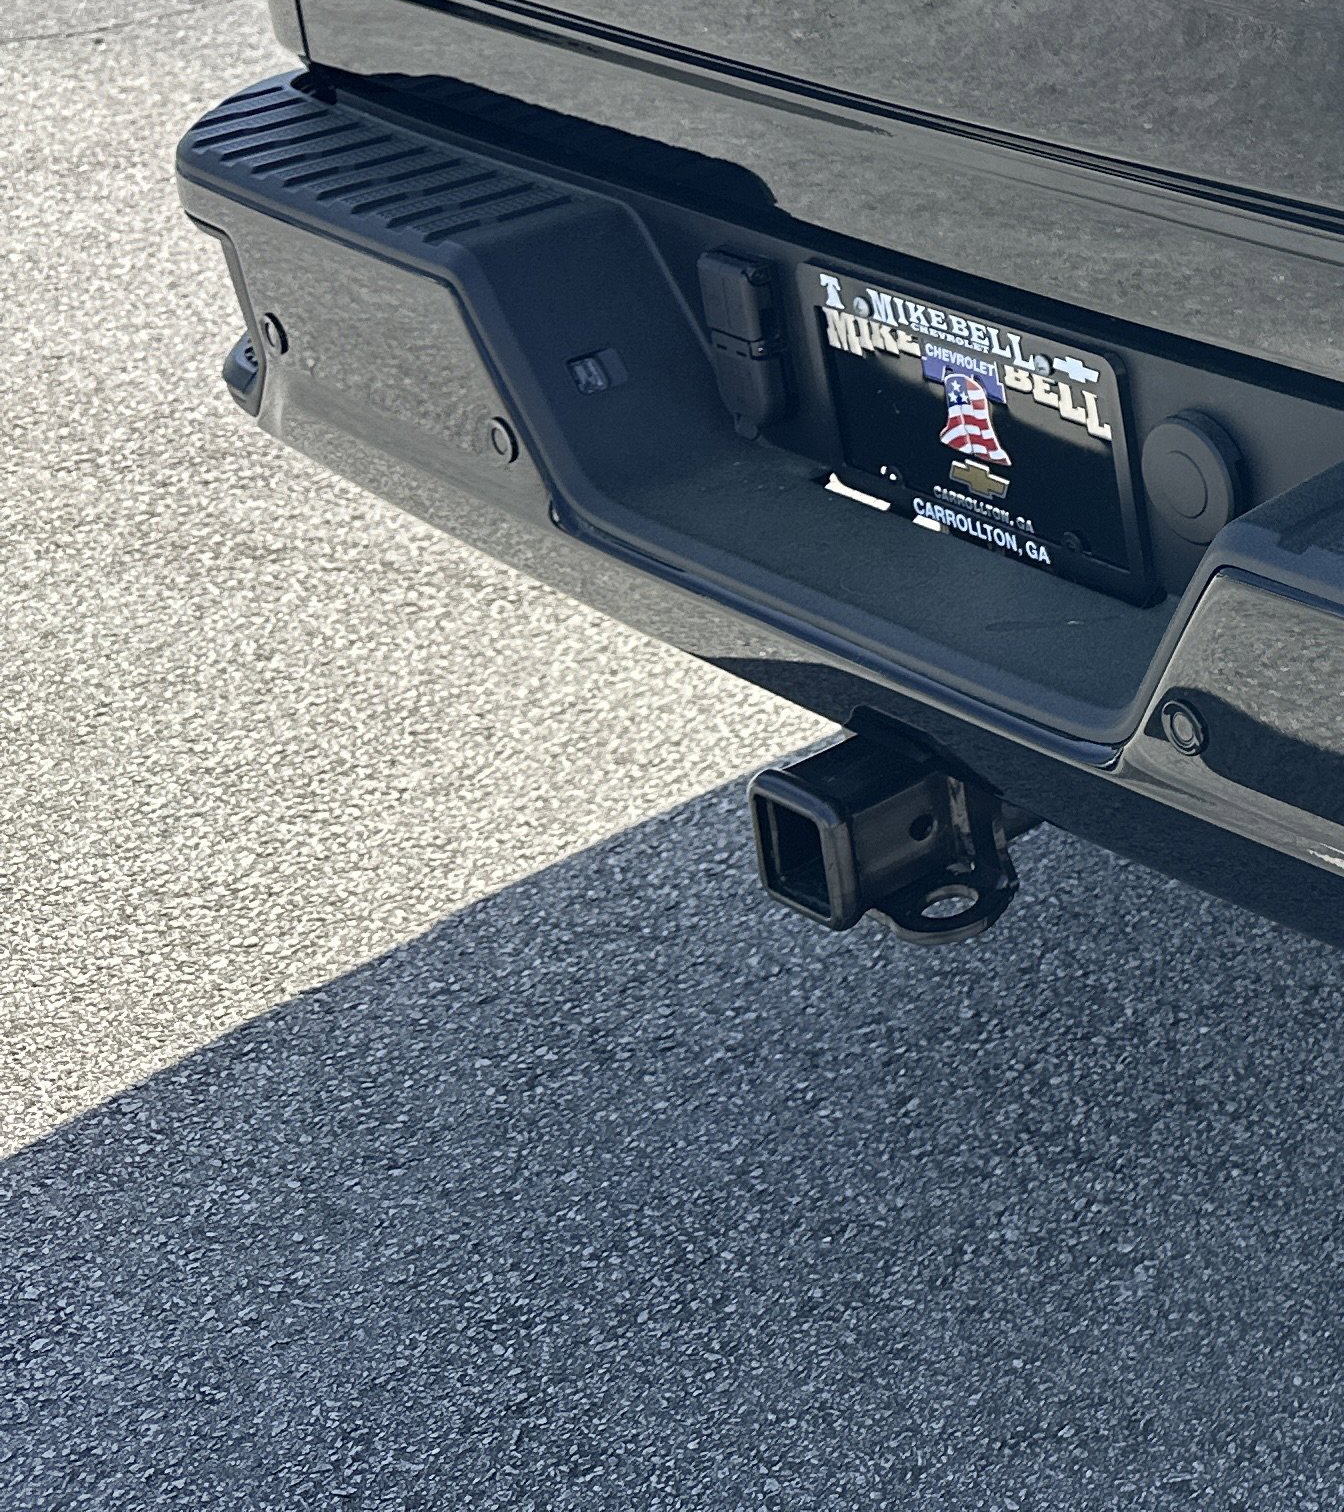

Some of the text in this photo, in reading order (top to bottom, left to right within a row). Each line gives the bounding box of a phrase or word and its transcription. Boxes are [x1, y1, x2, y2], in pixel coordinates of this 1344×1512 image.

[909, 322, 991, 354] CHEVROLET
[924, 342, 995, 377] CHEVROLET
[822, 306, 1113, 442] MIKE BELL
[913, 497, 1051, 565] CARROLLTON, GA
[933, 485, 1035, 534] CARROLLTON, GA
